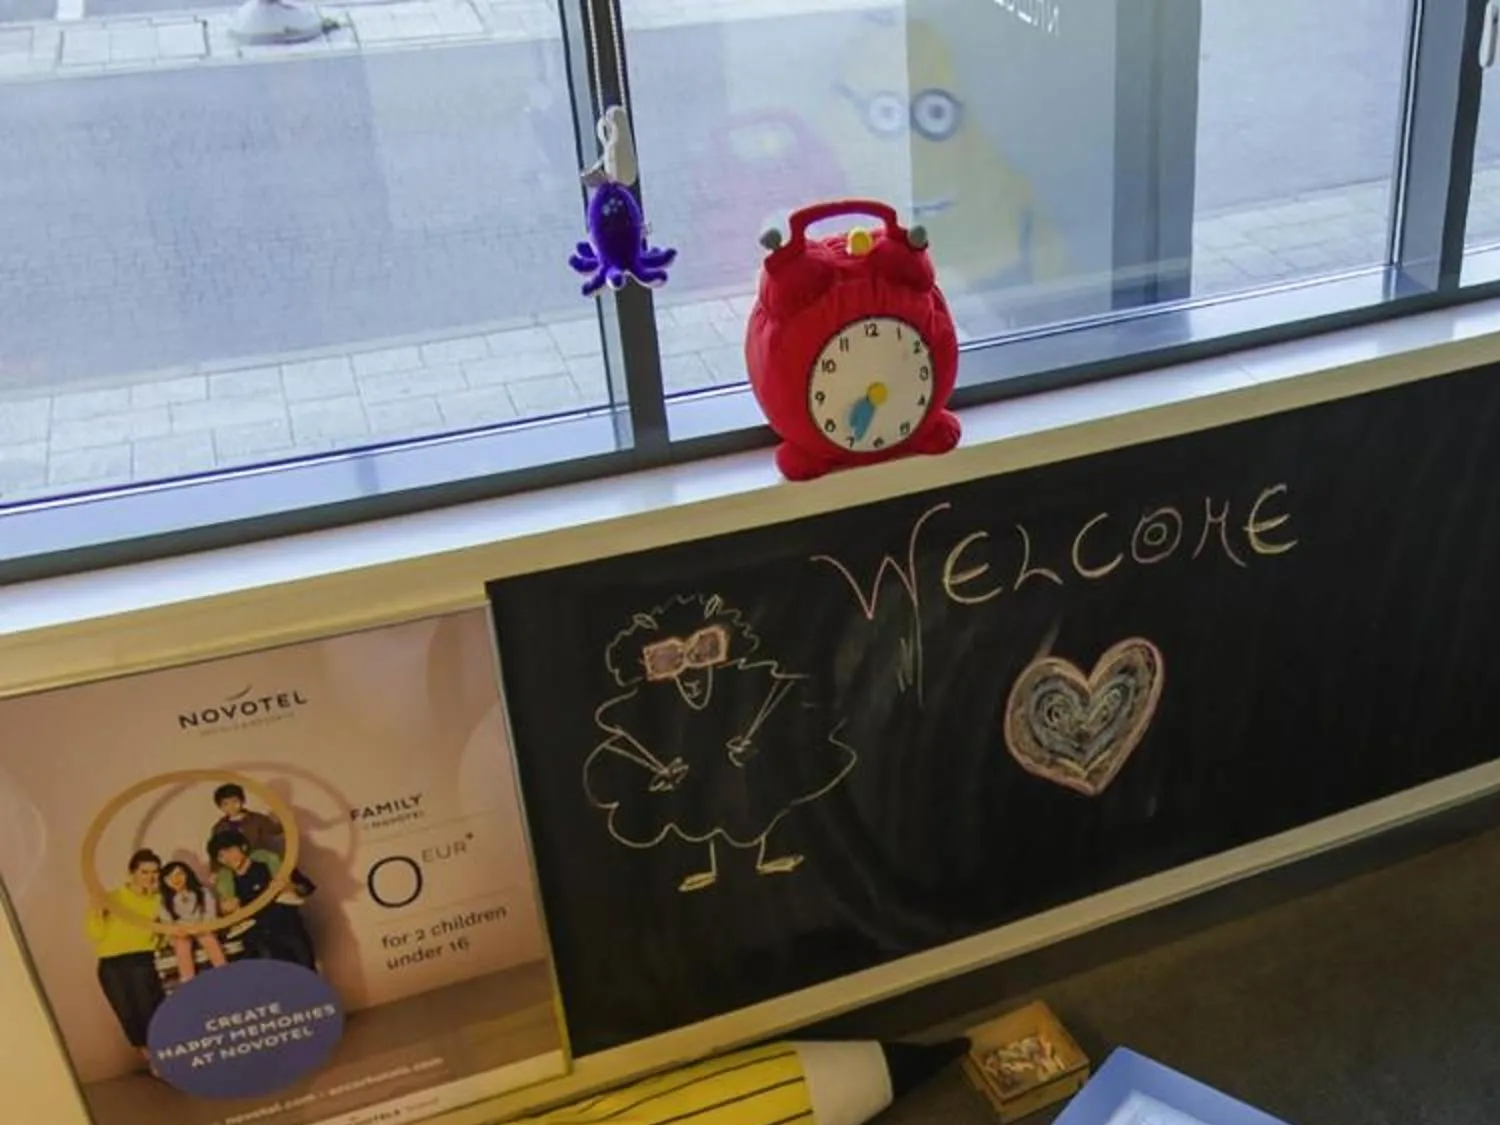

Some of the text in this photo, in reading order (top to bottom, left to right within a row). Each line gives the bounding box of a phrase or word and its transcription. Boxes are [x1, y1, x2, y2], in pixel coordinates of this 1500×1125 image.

[839, 337, 850, 352] 11
[864, 323, 879, 338] 12
[821, 358, 836, 374] 10
[814, 390, 826, 406] 9
[809, 483, 1299, 706] WELCOME
[178, 691, 308, 729] NOVOTEL
[350, 793, 422, 821] FAMILY
[381, 905, 508, 949] for 2 children
[386, 936, 470, 971] under 16
[157, 1004, 336, 1060] HAPPY MEMORIES
[204, 1002, 281, 1032] CREATE
[191, 1027, 314, 1069] AT NOVOTEL
